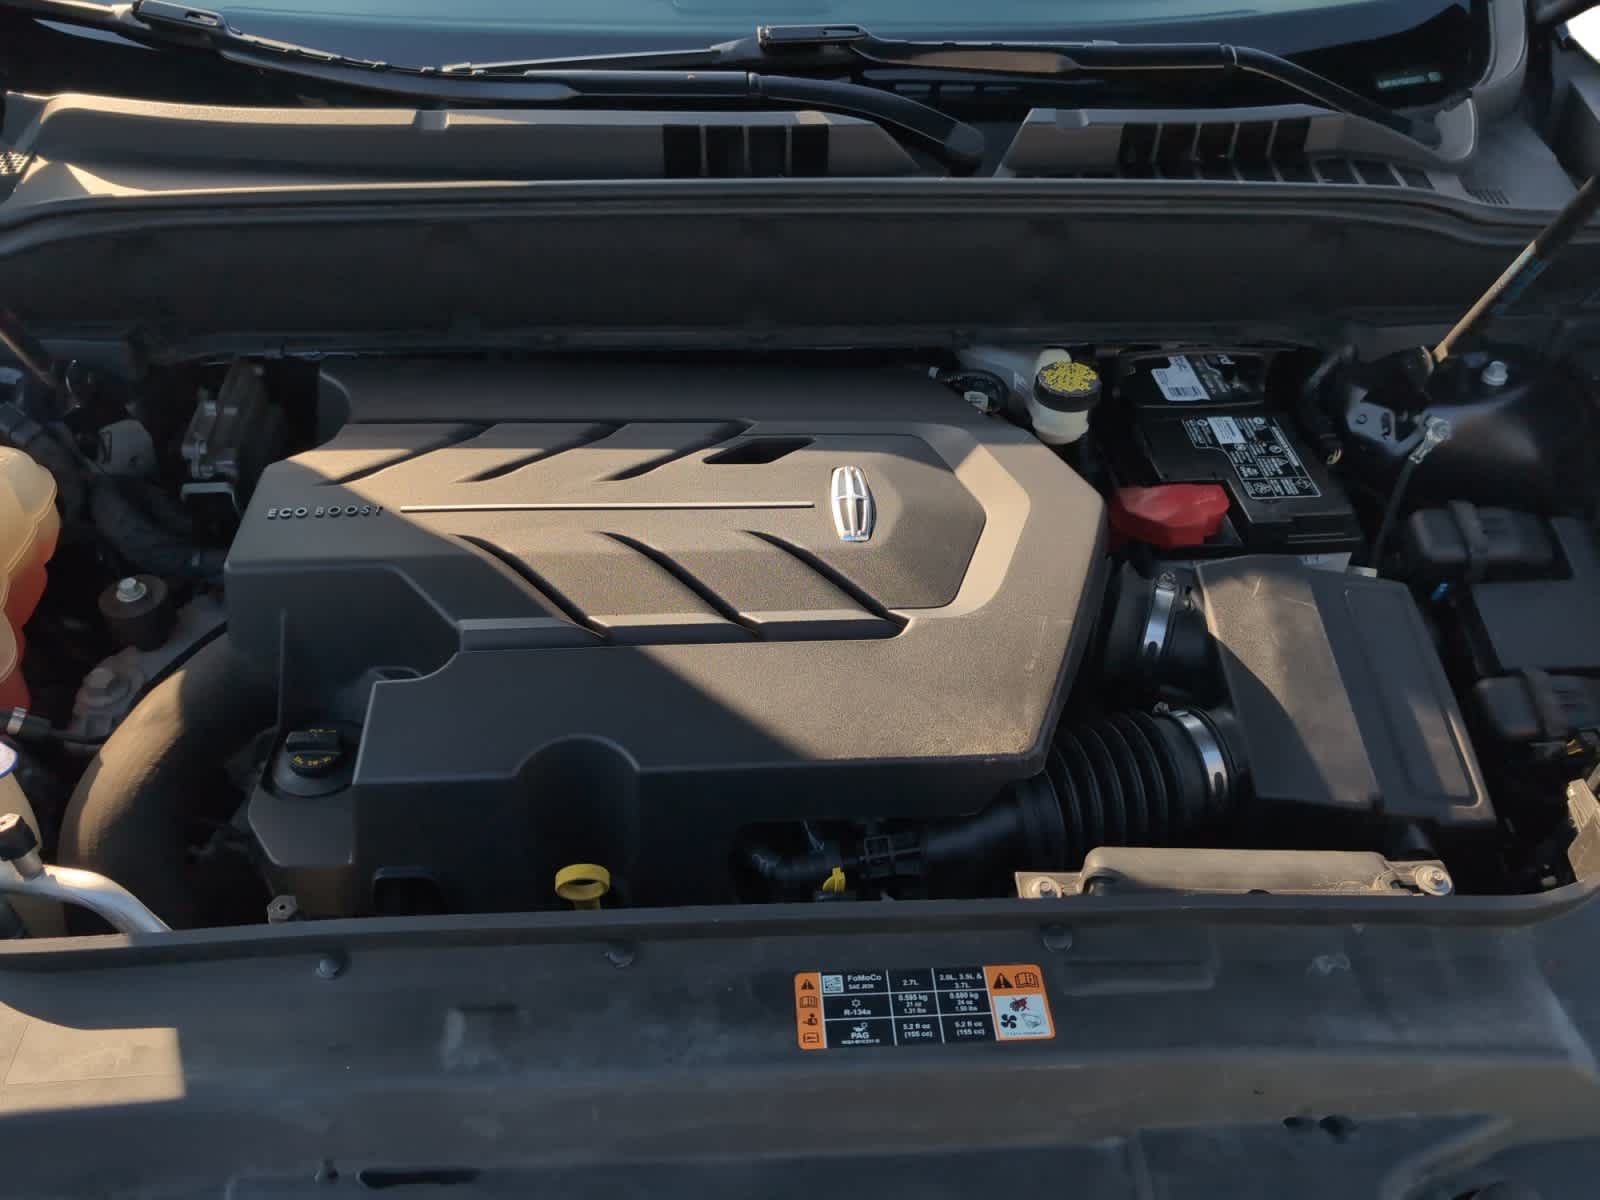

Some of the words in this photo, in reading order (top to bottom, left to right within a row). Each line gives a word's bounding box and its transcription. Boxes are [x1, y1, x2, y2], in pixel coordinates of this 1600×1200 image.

[267, 506, 308, 519] ECO
[315, 505, 383, 518] BOOST
[847, 974, 882, 982] FoMoCo
[902, 979, 920, 987] 2.7L
[843, 1008, 872, 1016] R-134a
[850, 1031, 870, 1039] PAG
